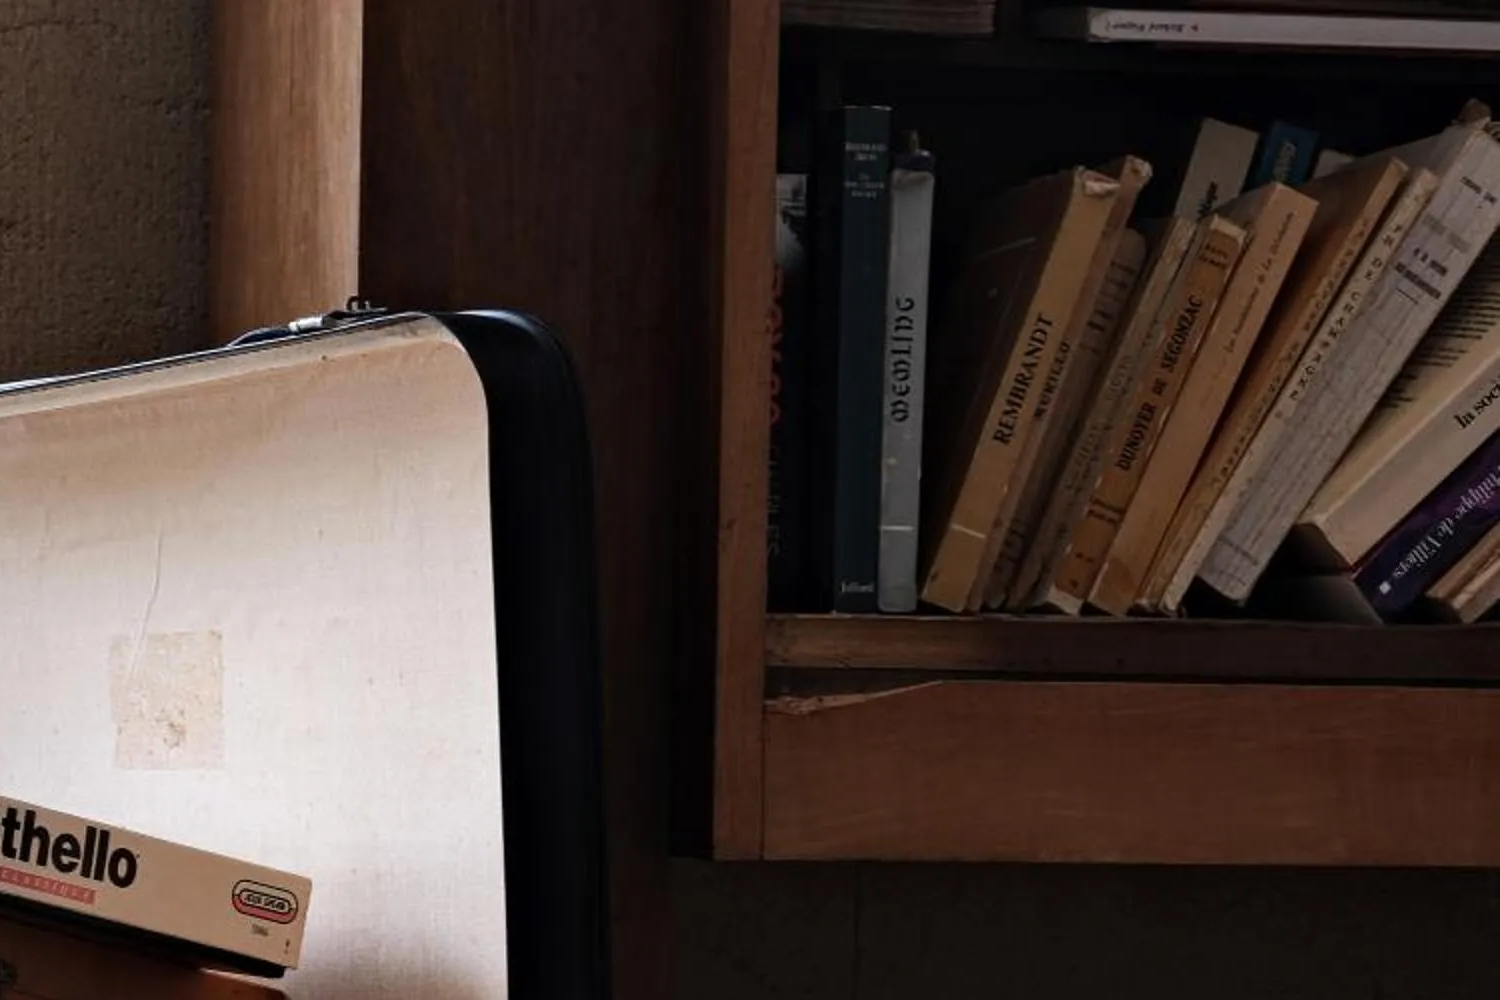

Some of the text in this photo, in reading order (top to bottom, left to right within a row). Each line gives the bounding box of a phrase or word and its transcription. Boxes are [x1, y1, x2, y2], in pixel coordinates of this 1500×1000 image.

[994, 313, 1054, 446] REMBRANDT
[1033, 342, 1071, 421] MURILLO
[1115, 402, 1157, 471] DUNOYER
[1161, 294, 1203, 374] SEGONZAC
[1453, 411, 1475, 430] la
[1392, 466, 1500, 578] hilippe de Villiers
